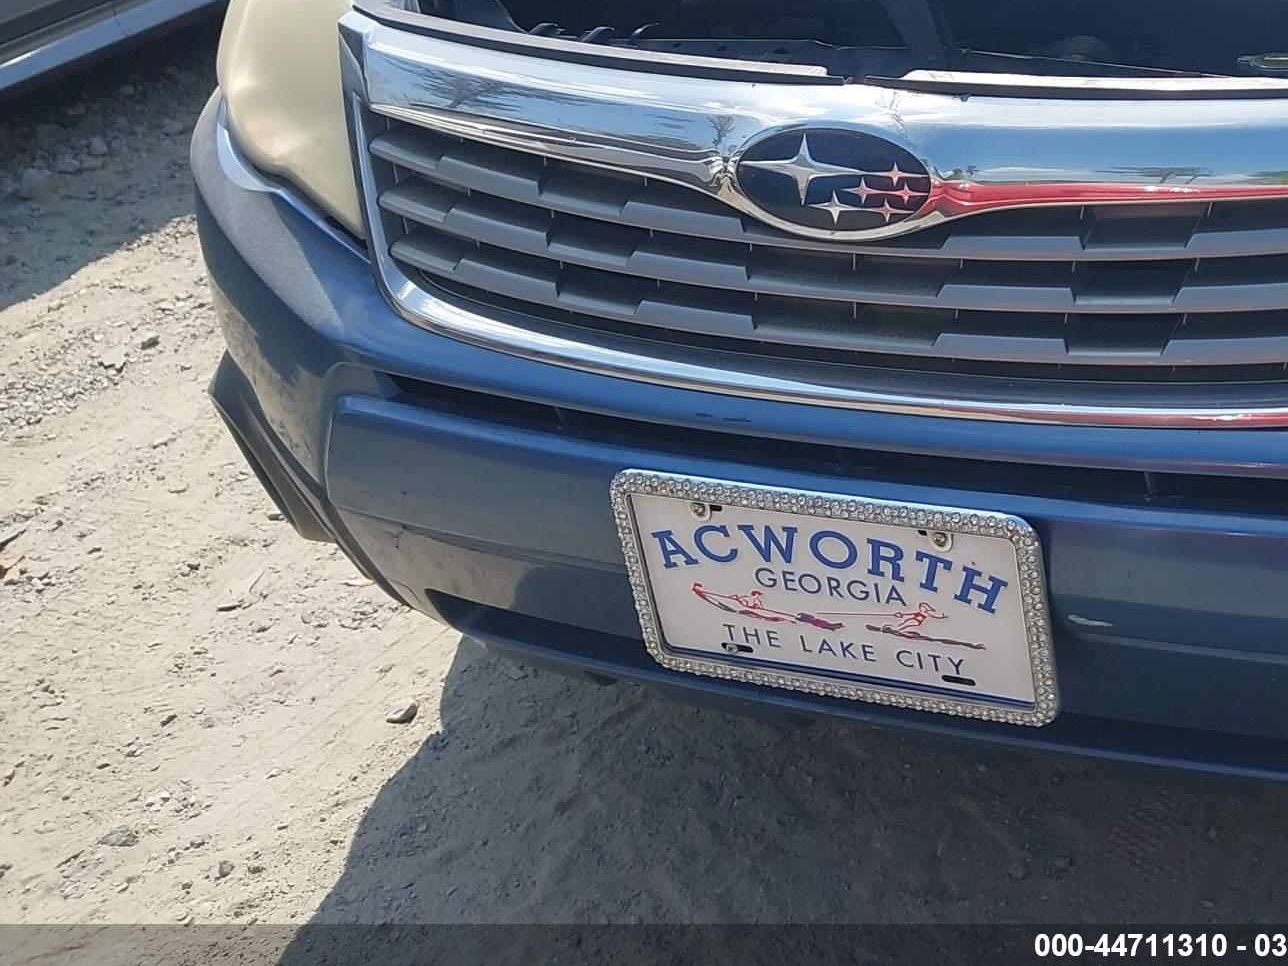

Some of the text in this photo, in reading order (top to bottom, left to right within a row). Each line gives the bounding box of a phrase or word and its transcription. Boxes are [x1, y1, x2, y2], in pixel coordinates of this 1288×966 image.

[651, 524, 1009, 614] ACWORTH
[755, 568, 907, 606] GEORGIA
[723, 623, 965, 675] THE LAKE CITY
